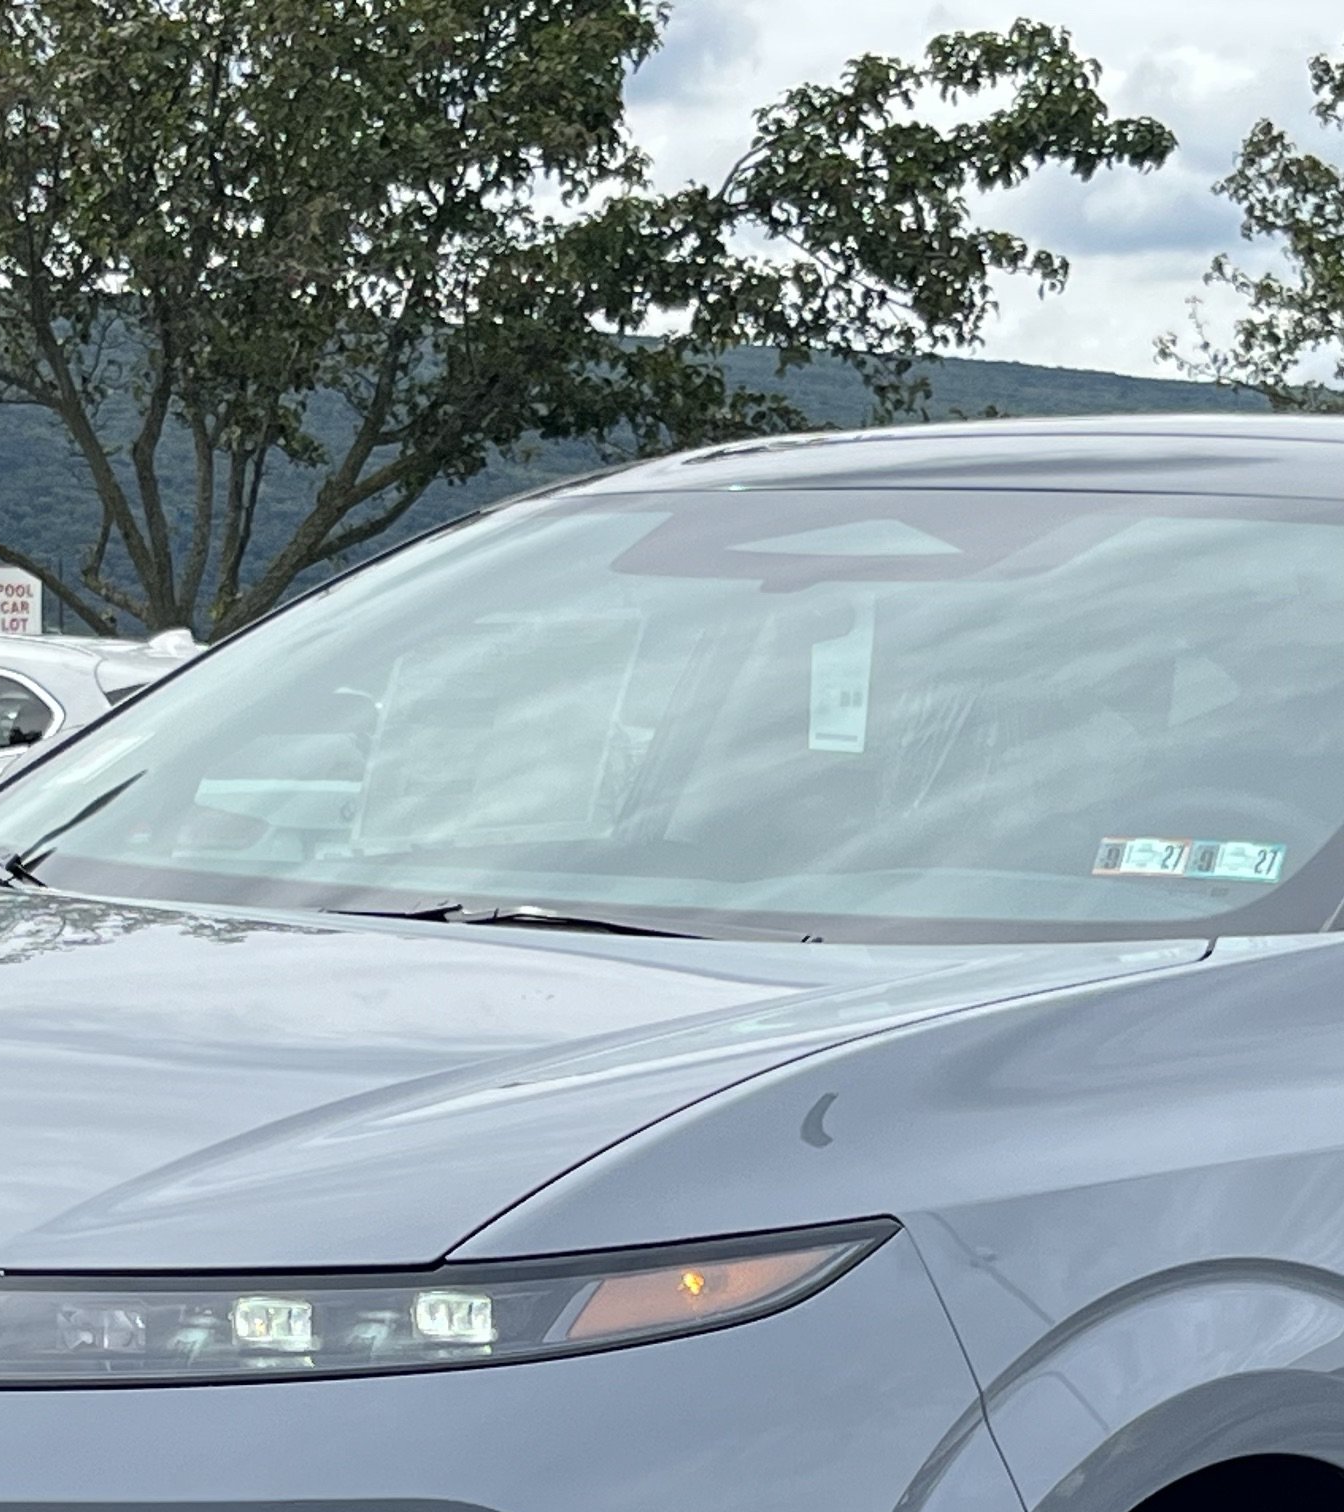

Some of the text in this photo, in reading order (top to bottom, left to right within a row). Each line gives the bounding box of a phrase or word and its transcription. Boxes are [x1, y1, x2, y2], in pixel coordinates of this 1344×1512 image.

[1, 601, 30, 614] CAR
[1, 618, 29, 632] LOT
[1161, 844, 1186, 872] 27
[1254, 849, 1279, 876] 27
